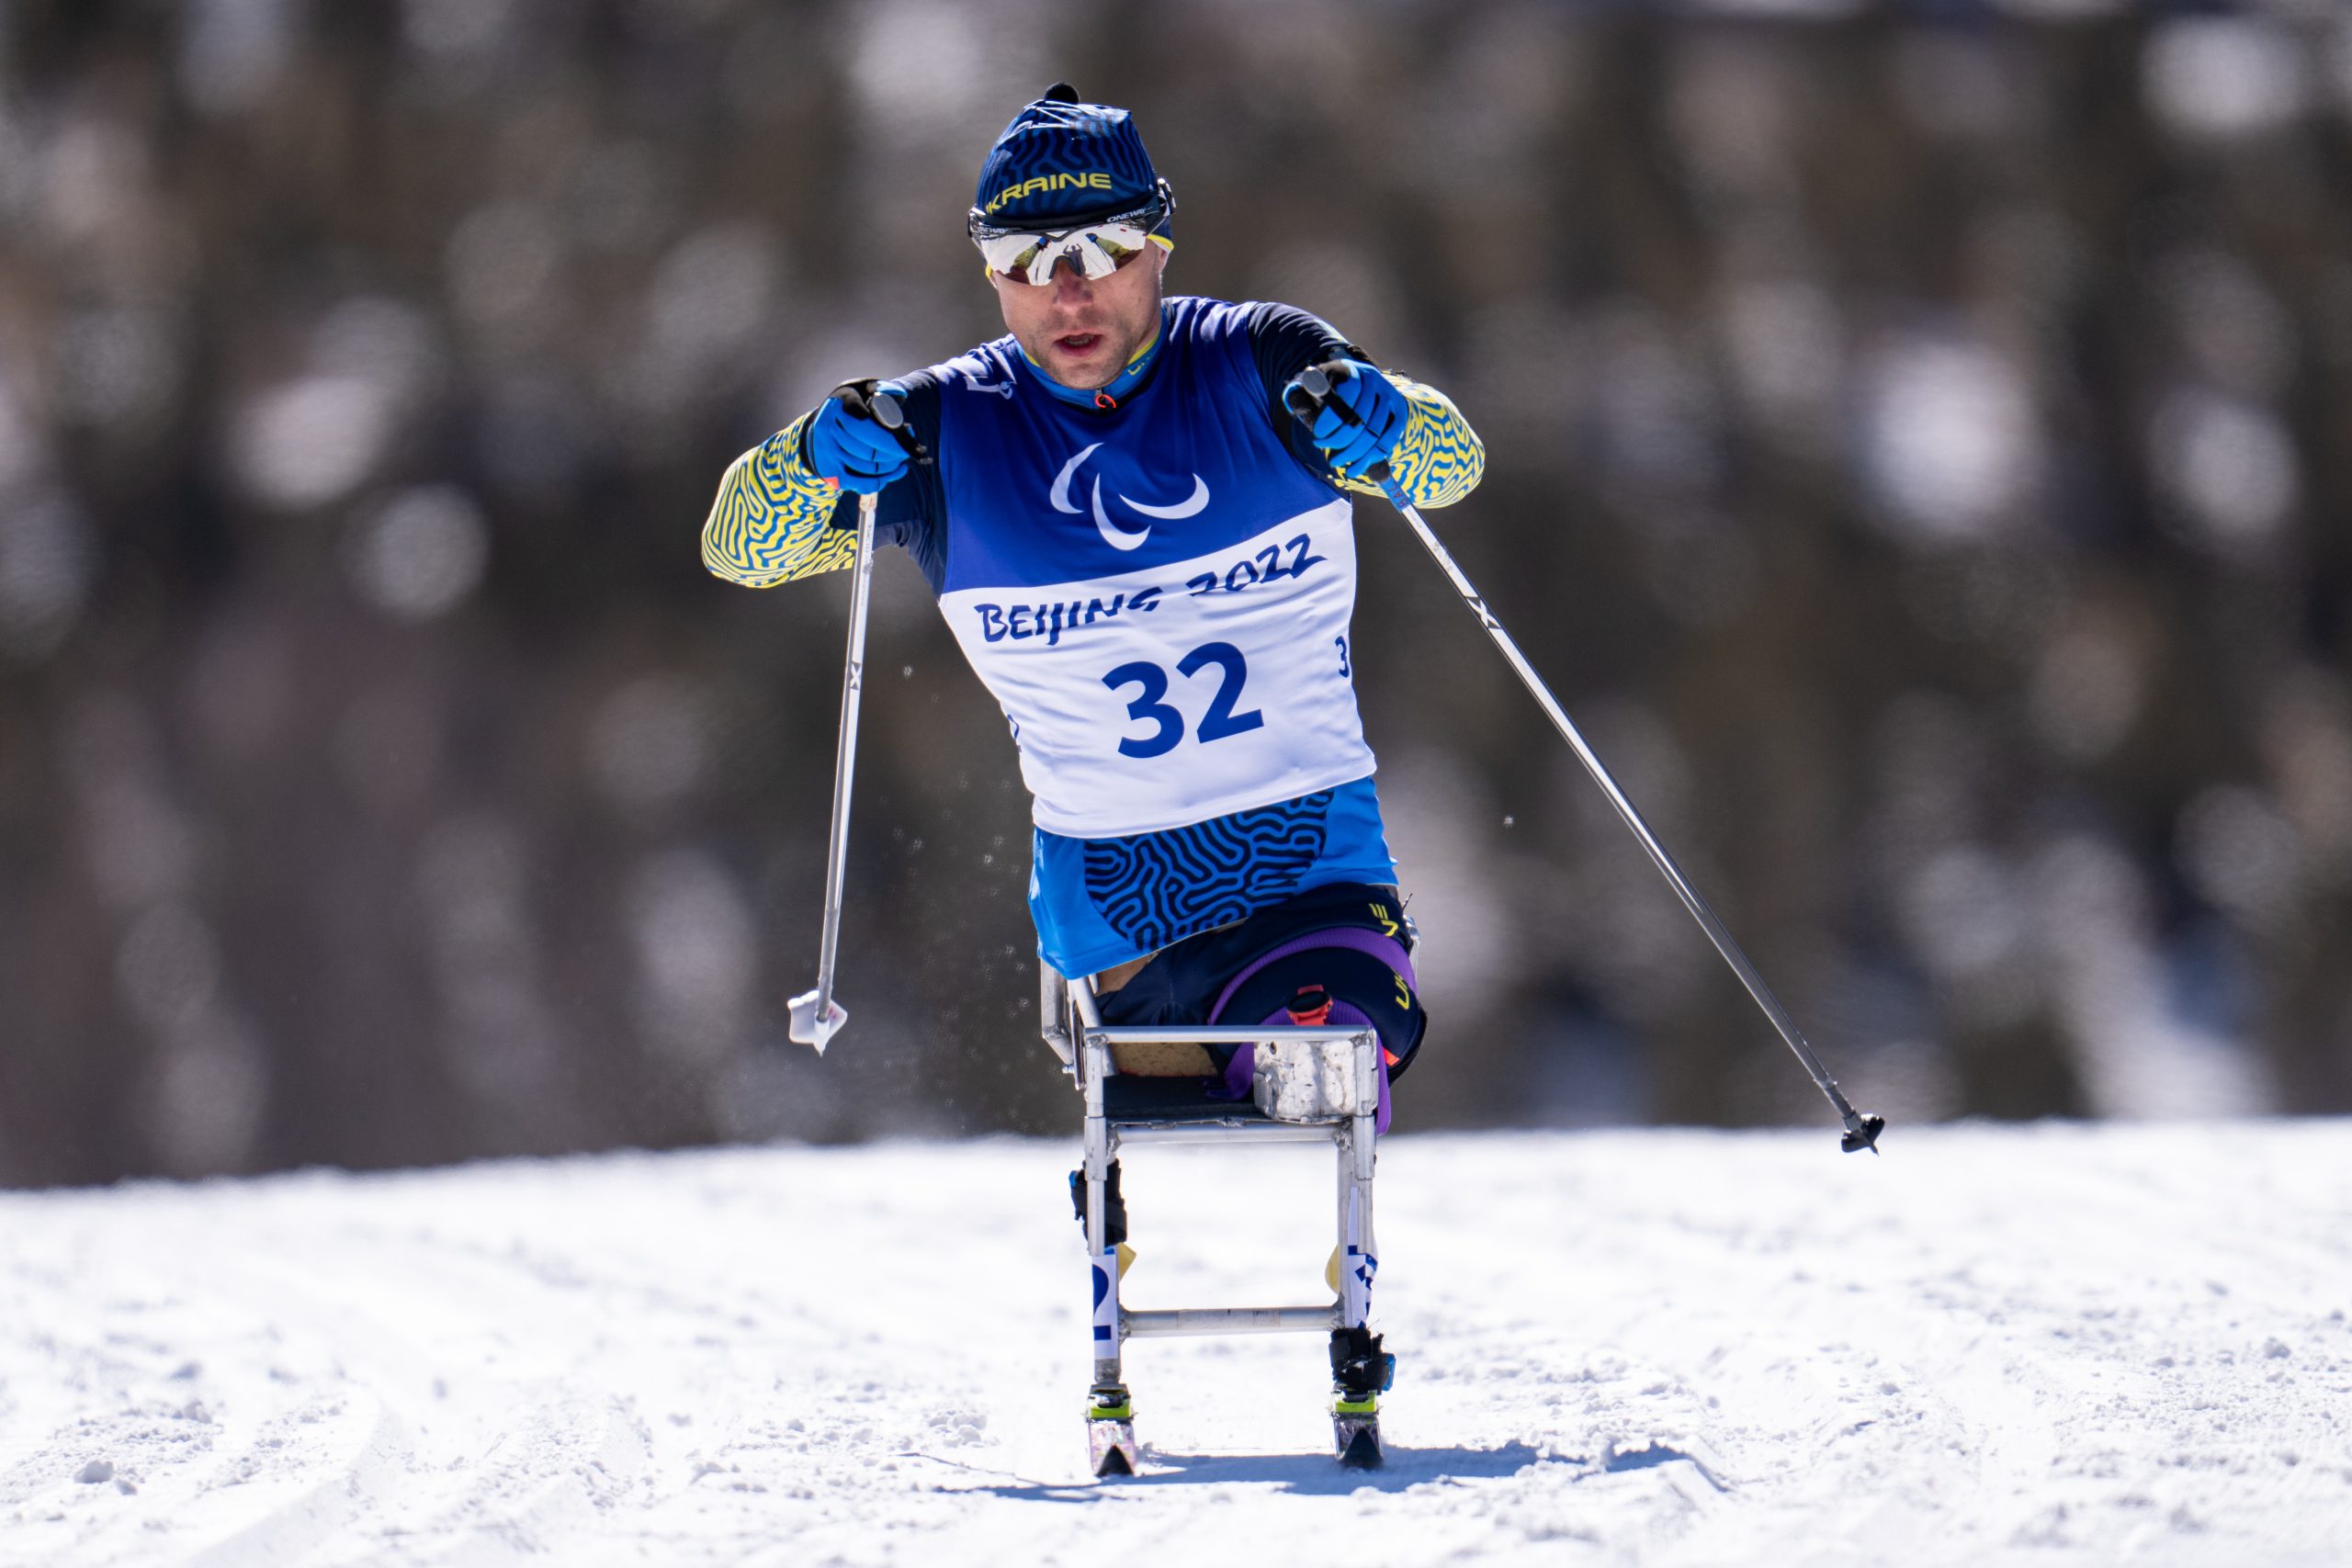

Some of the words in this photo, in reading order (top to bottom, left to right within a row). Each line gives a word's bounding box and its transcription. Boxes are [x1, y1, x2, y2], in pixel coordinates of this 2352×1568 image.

[986, 173, 1112, 215] KRAINE
[1106, 208, 1147, 222] ONEWAY
[974, 586, 1163, 646] BEIJING
[1186, 532, 1329, 597] 2022
[1102, 641, 1264, 759] 32
